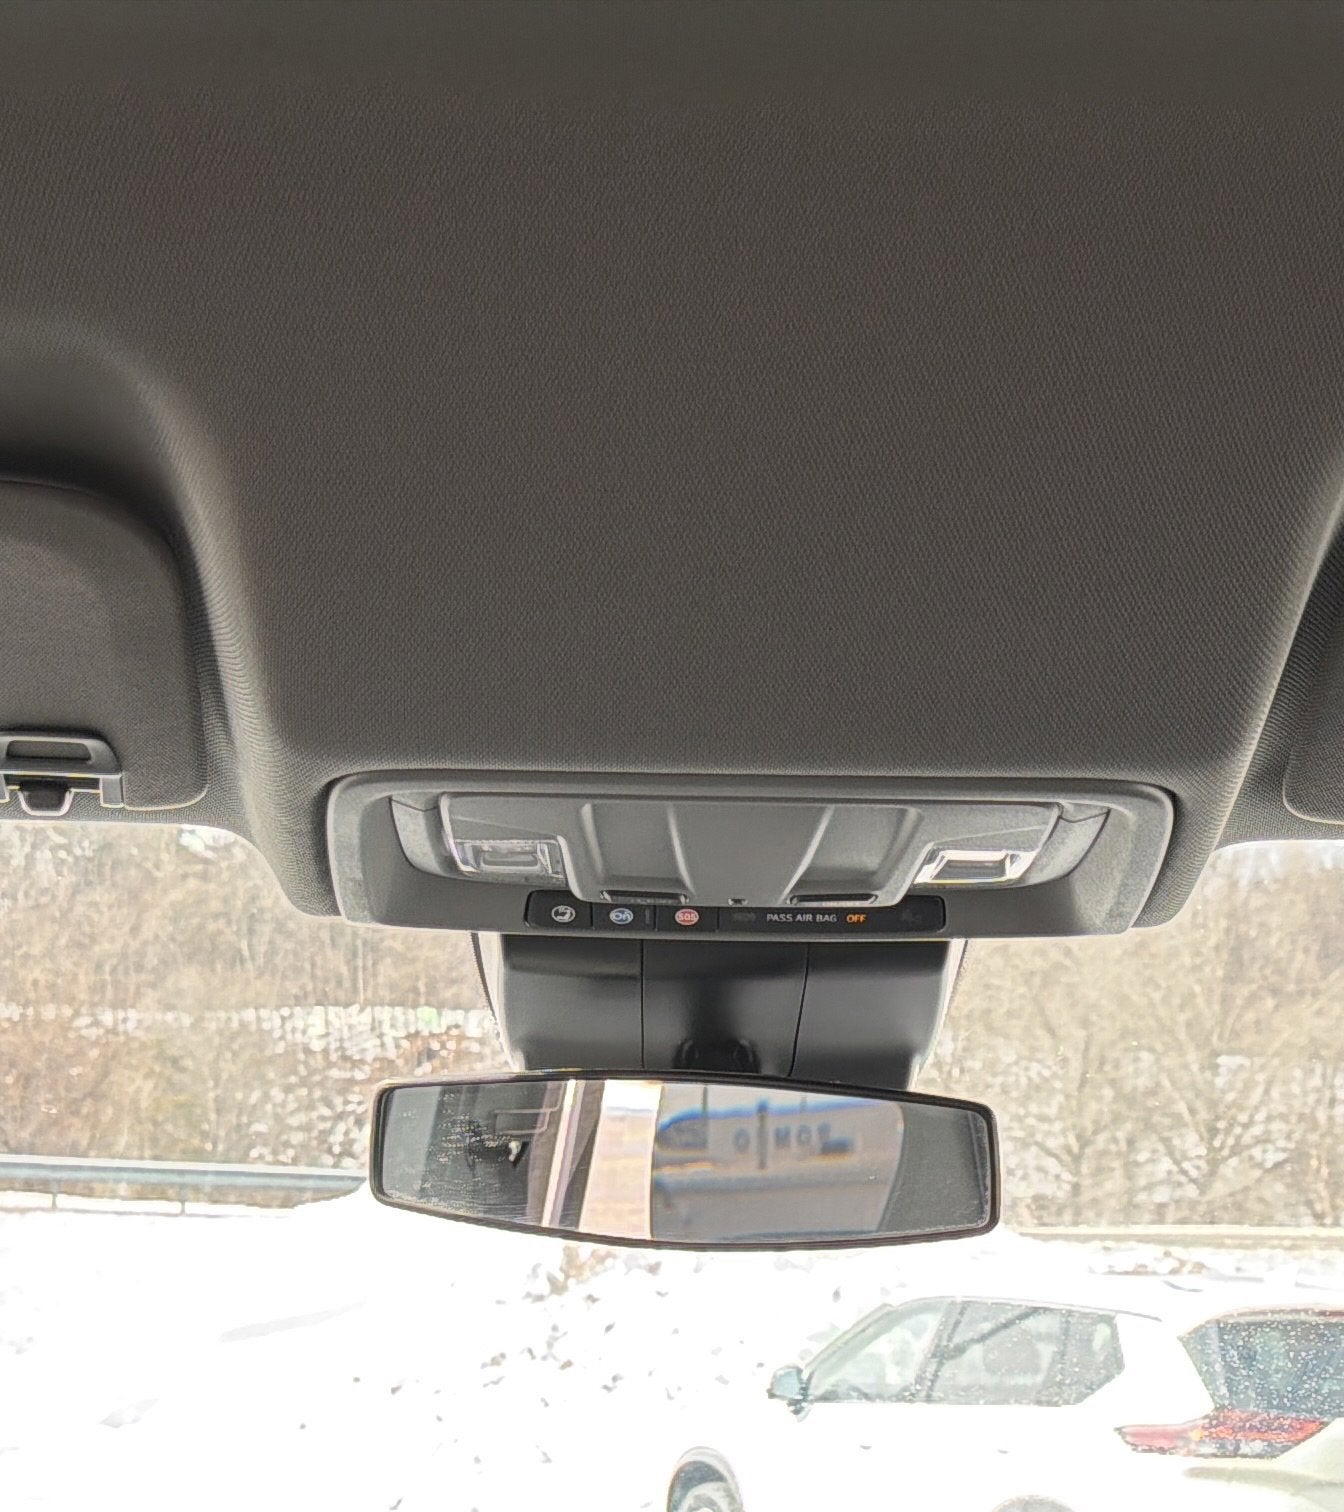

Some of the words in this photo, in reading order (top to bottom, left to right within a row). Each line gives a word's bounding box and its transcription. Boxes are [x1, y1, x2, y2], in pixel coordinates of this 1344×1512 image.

[766, 913, 793, 922] PASS
[795, 914, 813, 922] AIR
[816, 914, 837, 923] BAG
[846, 913, 867, 923] OFF
